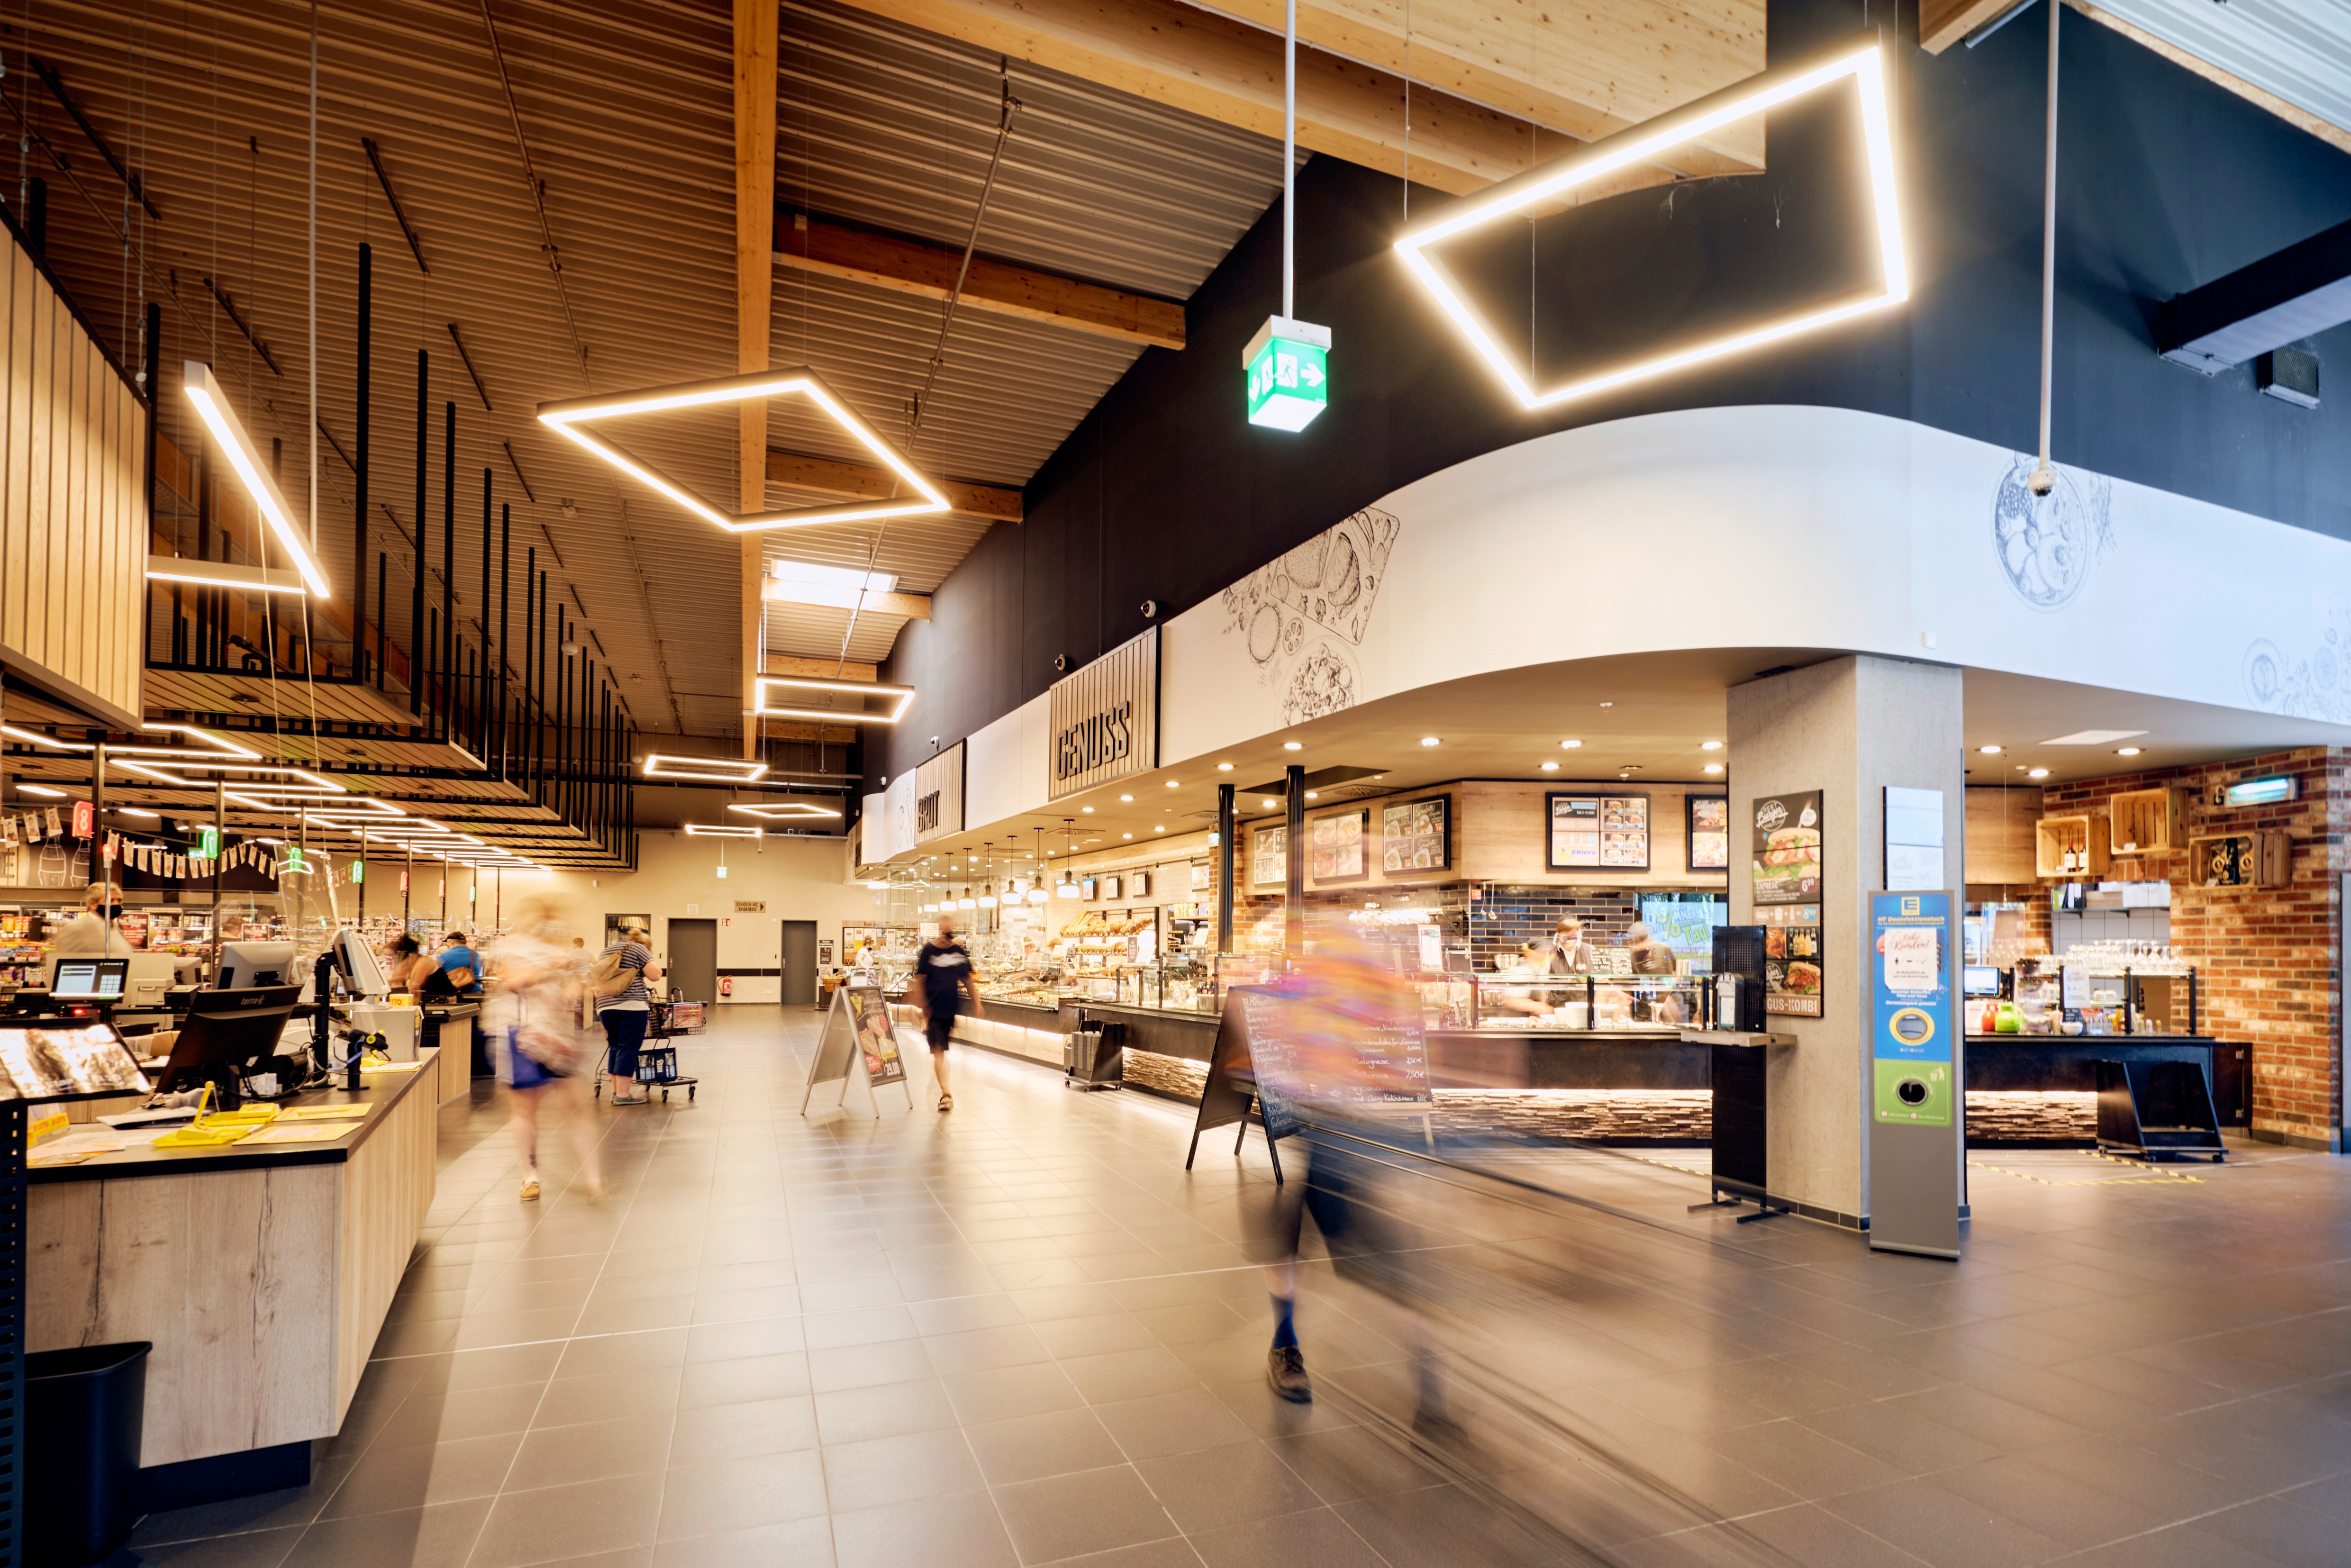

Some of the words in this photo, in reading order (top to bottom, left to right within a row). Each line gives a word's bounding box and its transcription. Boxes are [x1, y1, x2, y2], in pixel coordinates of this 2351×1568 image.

[1057, 700, 1129, 780] GENUSS
[918, 790, 939, 833] BROT
[1763, 802, 1777, 813] BEST
[79, 809, 89, 831] 8
[1756, 806, 1788, 829] Burger
[1555, 820, 1597, 828] ANGUS-KOMBI
[1756, 882, 1779, 890] CAPRESE
[1682, 923, 1710, 946] Tag!
[1895, 940, 1929, 951] Kunden!
[241, 997, 258, 1006] terra
[1767, 997, 1817, 1013] GUS-KOMBI
[1353, 1057, 1390, 1069] Bolognese
[1406, 1057, 1423, 1065] 7,50€
[1406, 1069, 1425, 1080] 7,50€
